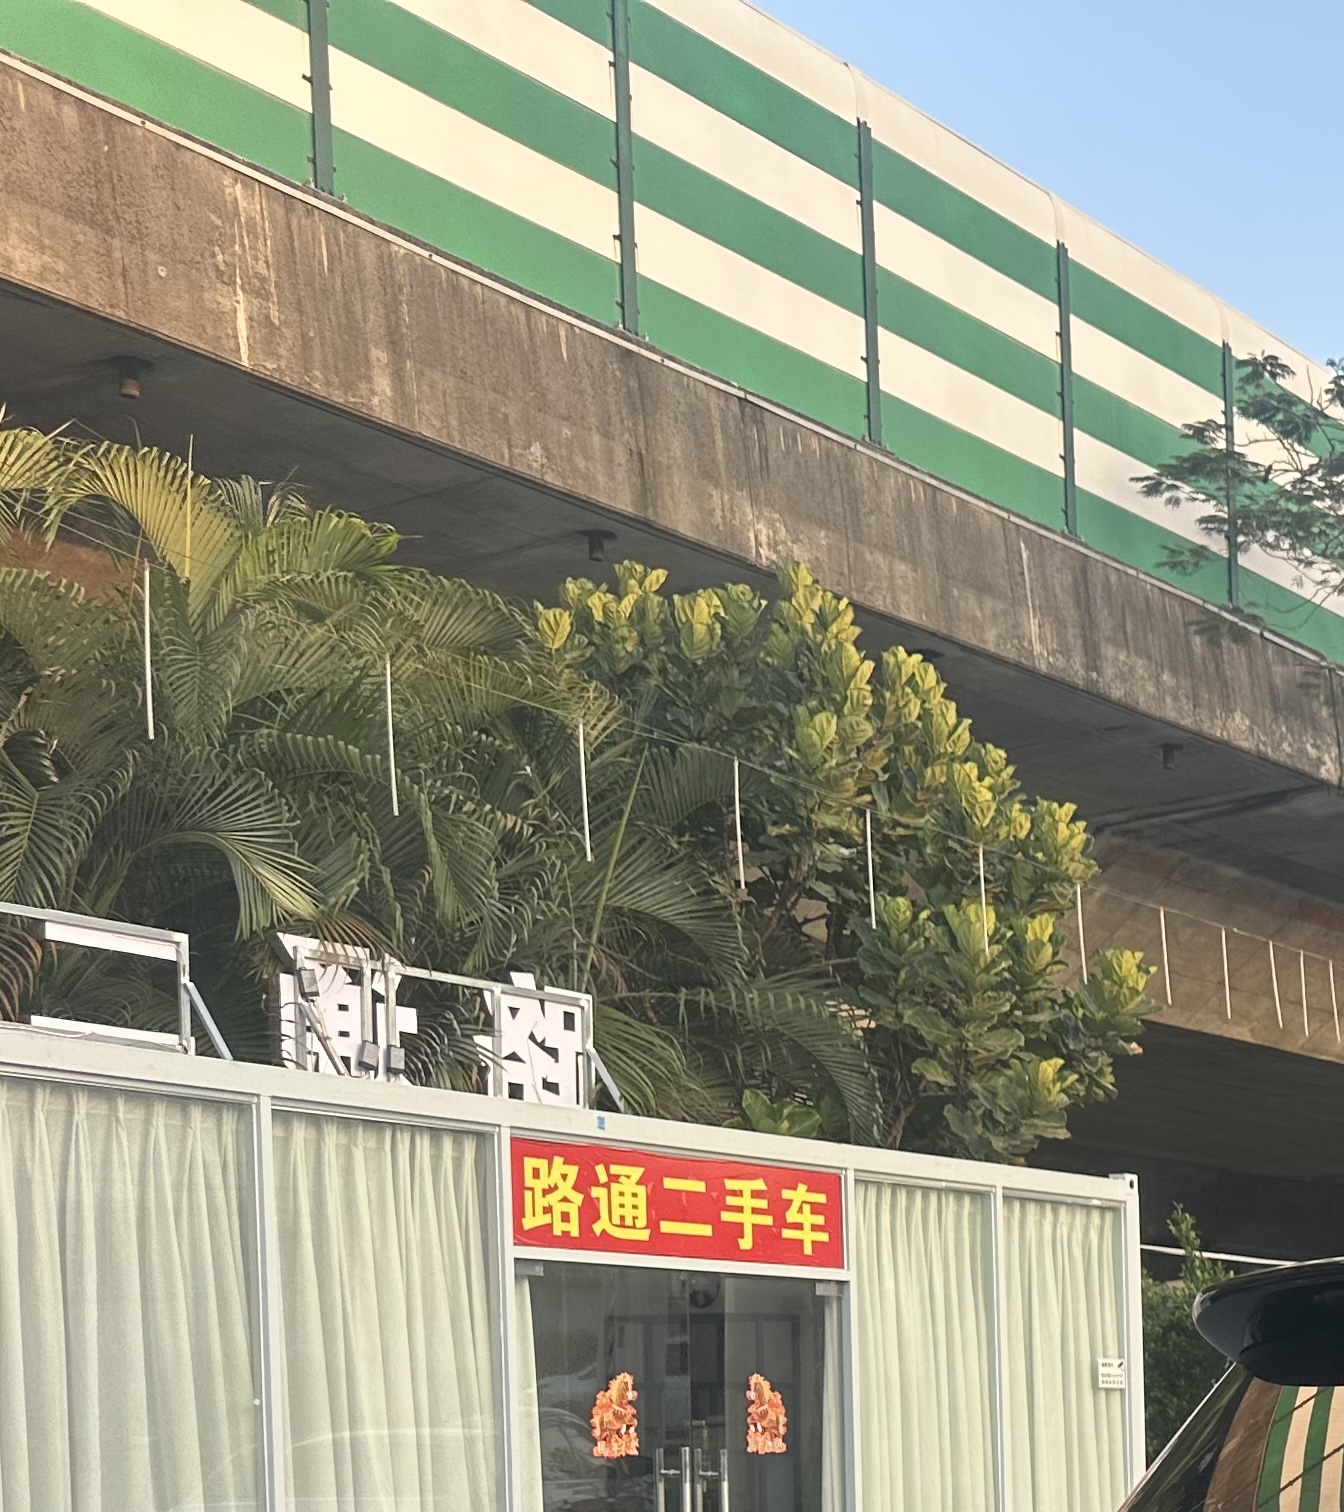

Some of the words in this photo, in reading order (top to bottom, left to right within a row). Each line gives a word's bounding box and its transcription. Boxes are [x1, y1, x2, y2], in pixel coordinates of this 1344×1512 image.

[522, 1156, 829, 1256] 路通二手车
